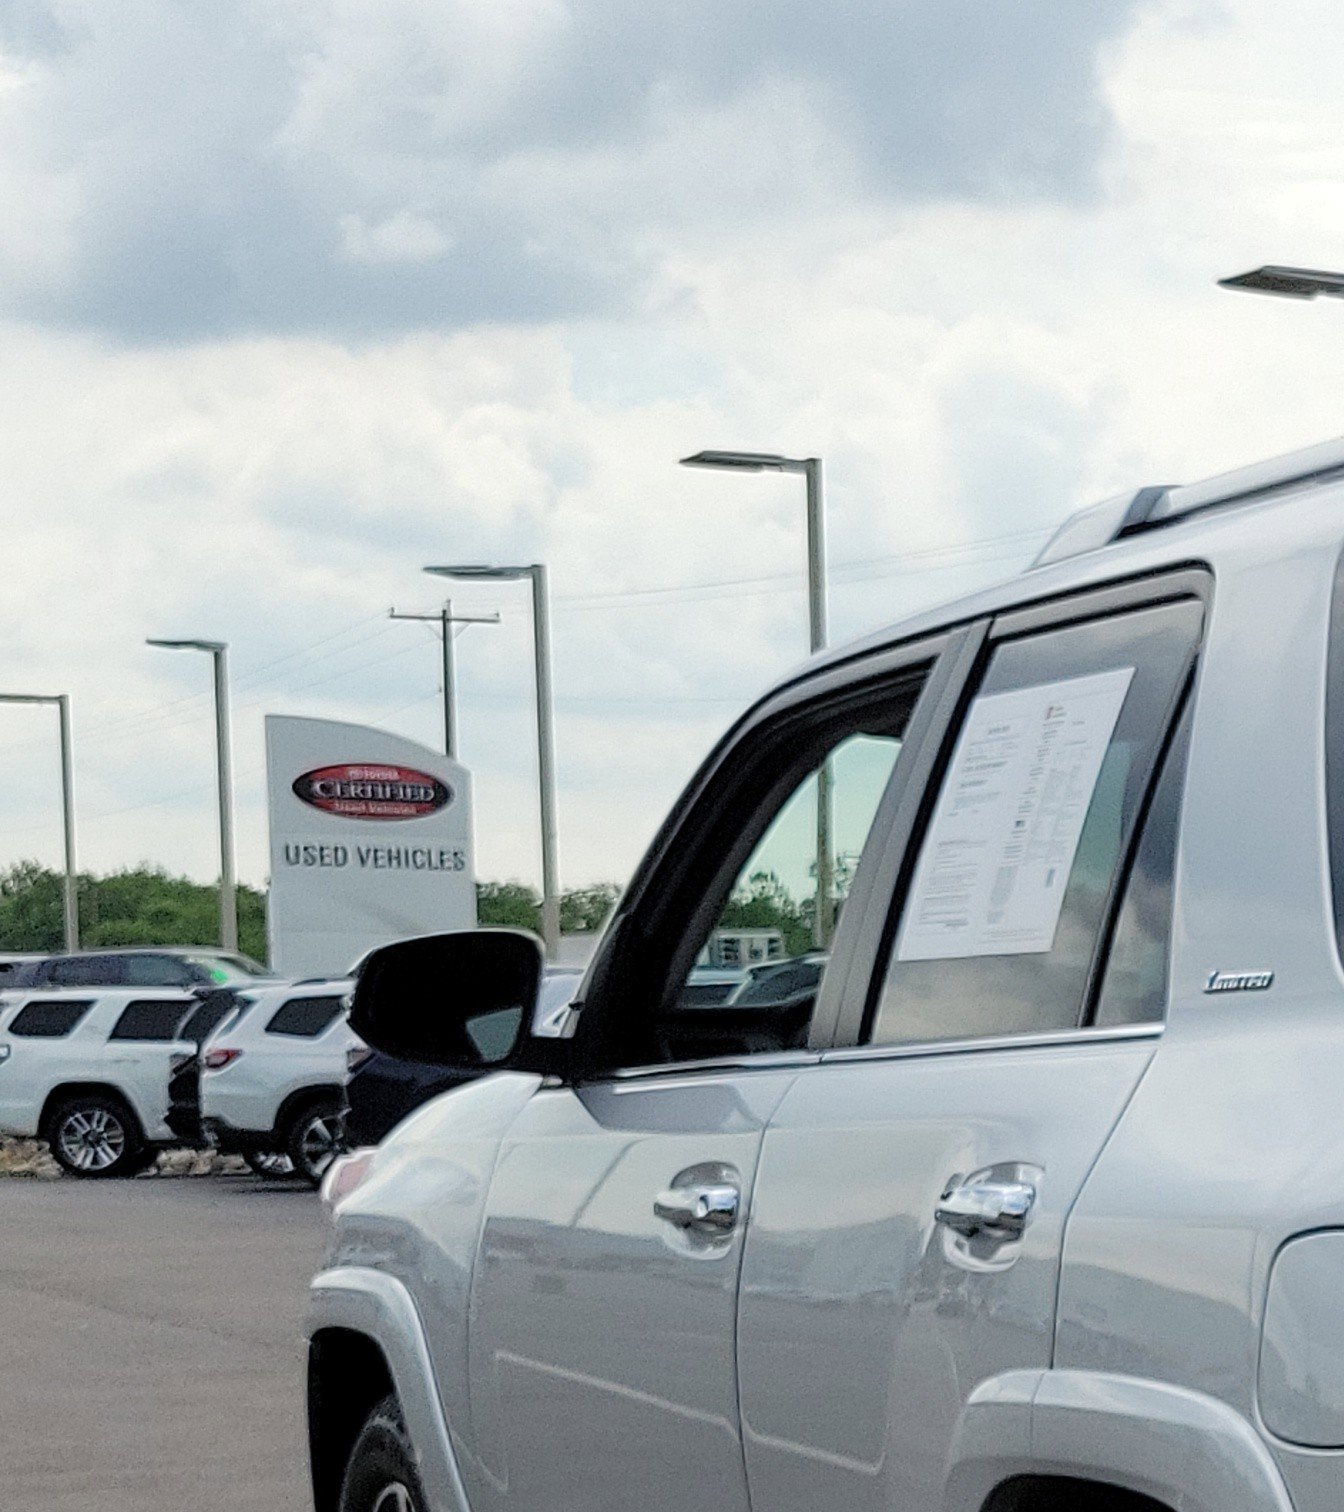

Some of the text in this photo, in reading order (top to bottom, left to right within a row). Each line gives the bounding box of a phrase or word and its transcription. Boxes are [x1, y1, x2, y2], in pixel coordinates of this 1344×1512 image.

[312, 779, 434, 802] CERTIFIED
[285, 844, 465, 871] USED VEHICLES
